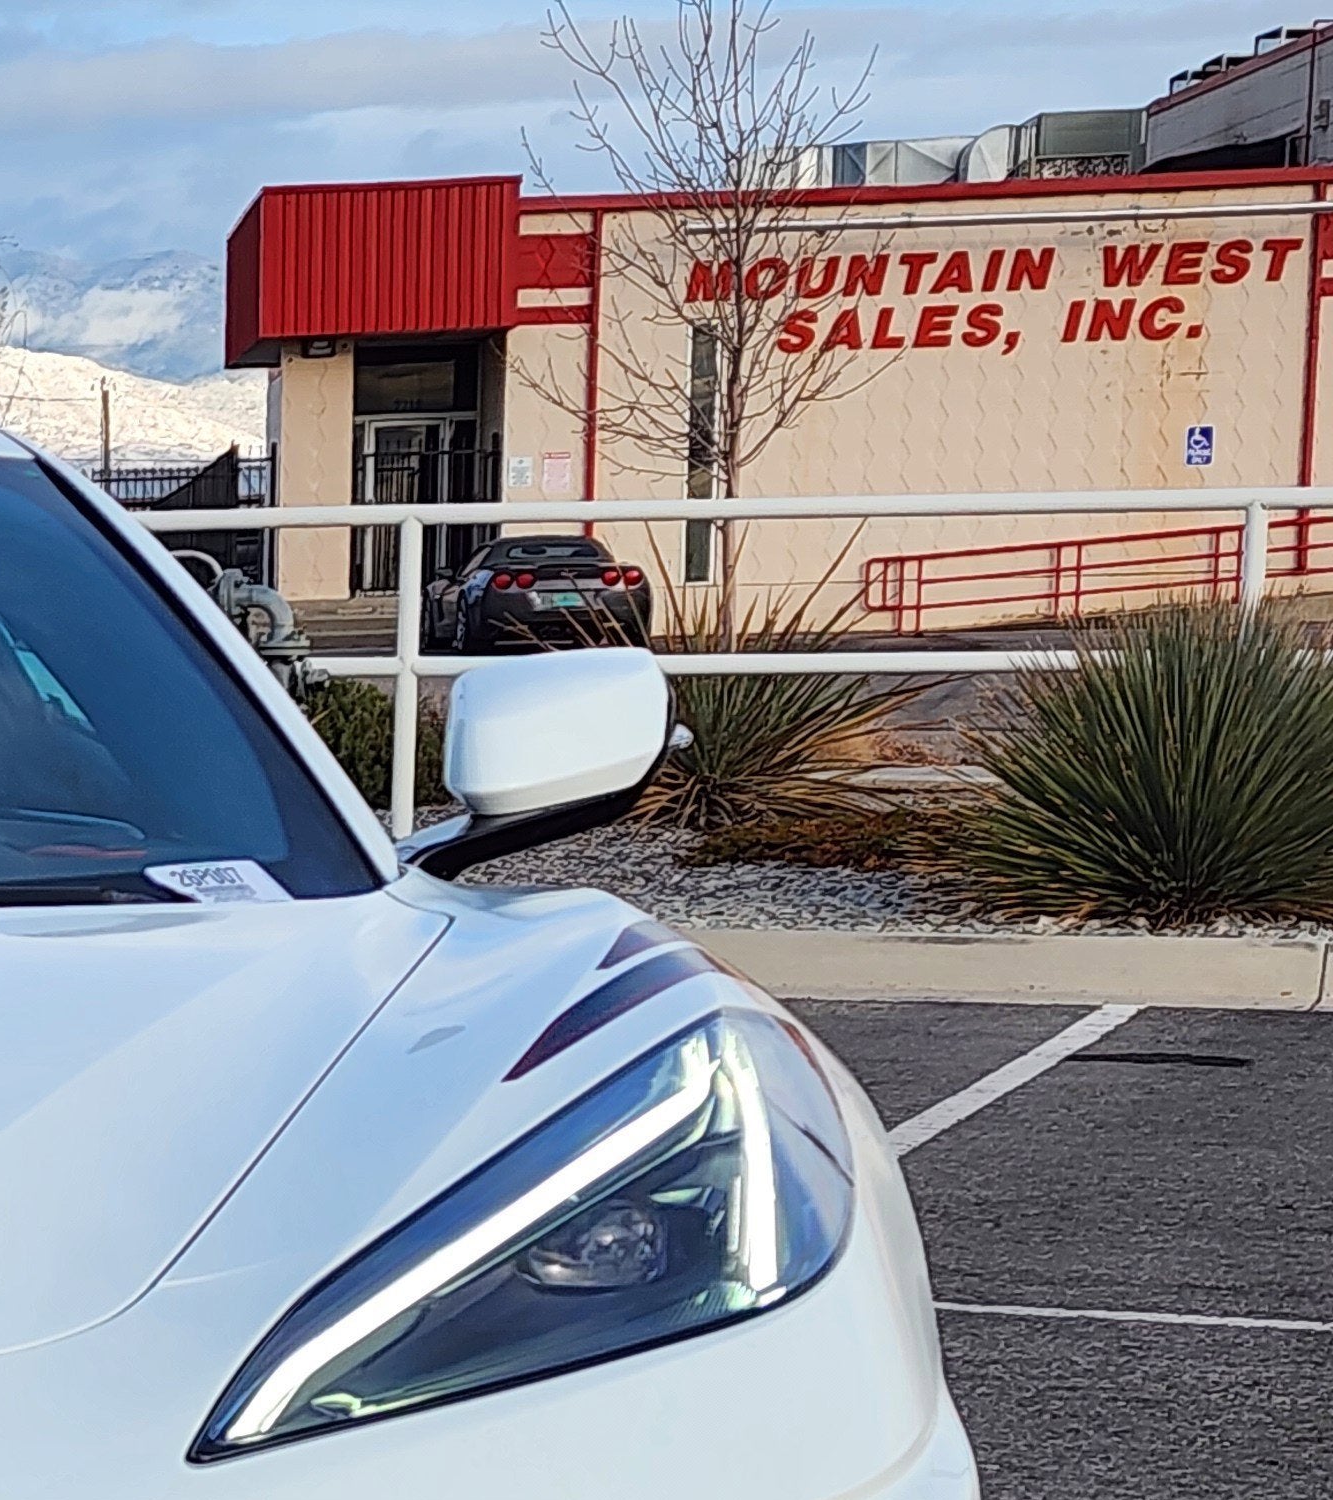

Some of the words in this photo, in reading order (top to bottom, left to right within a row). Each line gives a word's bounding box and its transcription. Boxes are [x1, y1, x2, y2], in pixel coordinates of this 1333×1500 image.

[684, 247, 1055, 303] MOUNTAIN
[1102, 238, 1305, 288] WEST
[776, 303, 1021, 356] SALES,
[1060, 295, 1203, 342] INC.
